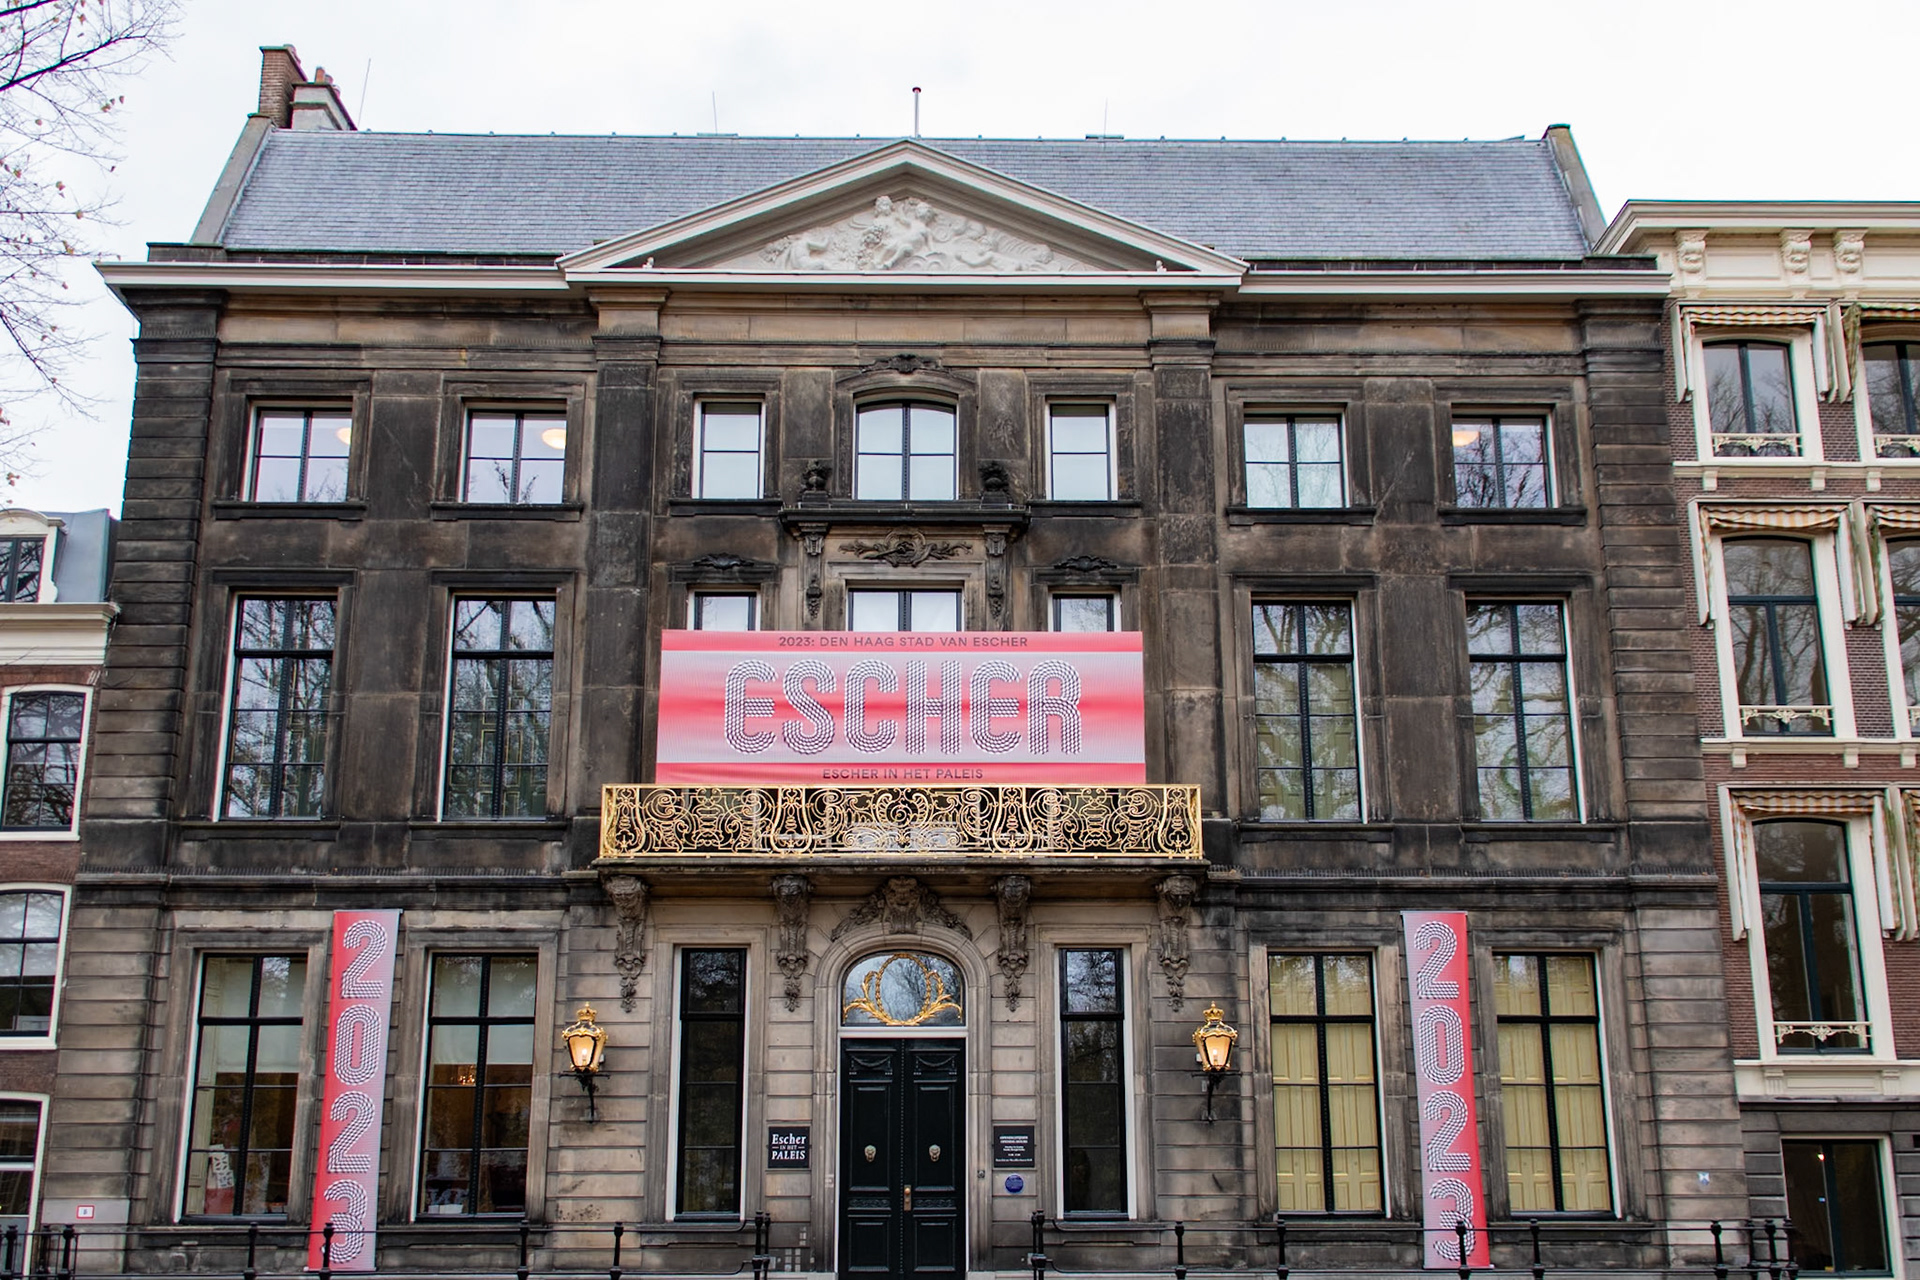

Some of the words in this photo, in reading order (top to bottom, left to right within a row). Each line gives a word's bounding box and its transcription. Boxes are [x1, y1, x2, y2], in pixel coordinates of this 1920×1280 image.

[779, 636, 815, 647] 2023:
[820, 637, 848, 647] DEN
[854, 637, 894, 647] HAAG
[899, 637, 934, 647] STAD
[940, 637, 967, 647] VAN
[973, 637, 1028, 647] ESCHER
[724, 659, 1082, 755] ESCHER
[823, 768, 879, 779] ESCHER
[884, 768, 898, 779] IN
[903, 768, 930, 779] HET
[936, 768, 983, 779] PALEIS
[322, 919, 388, 1264] 2023
[1413, 920, 1476, 1262] 2023
[771, 1133, 807, 1144] Escher
[771, 1150, 806, 1160] PALEIS
